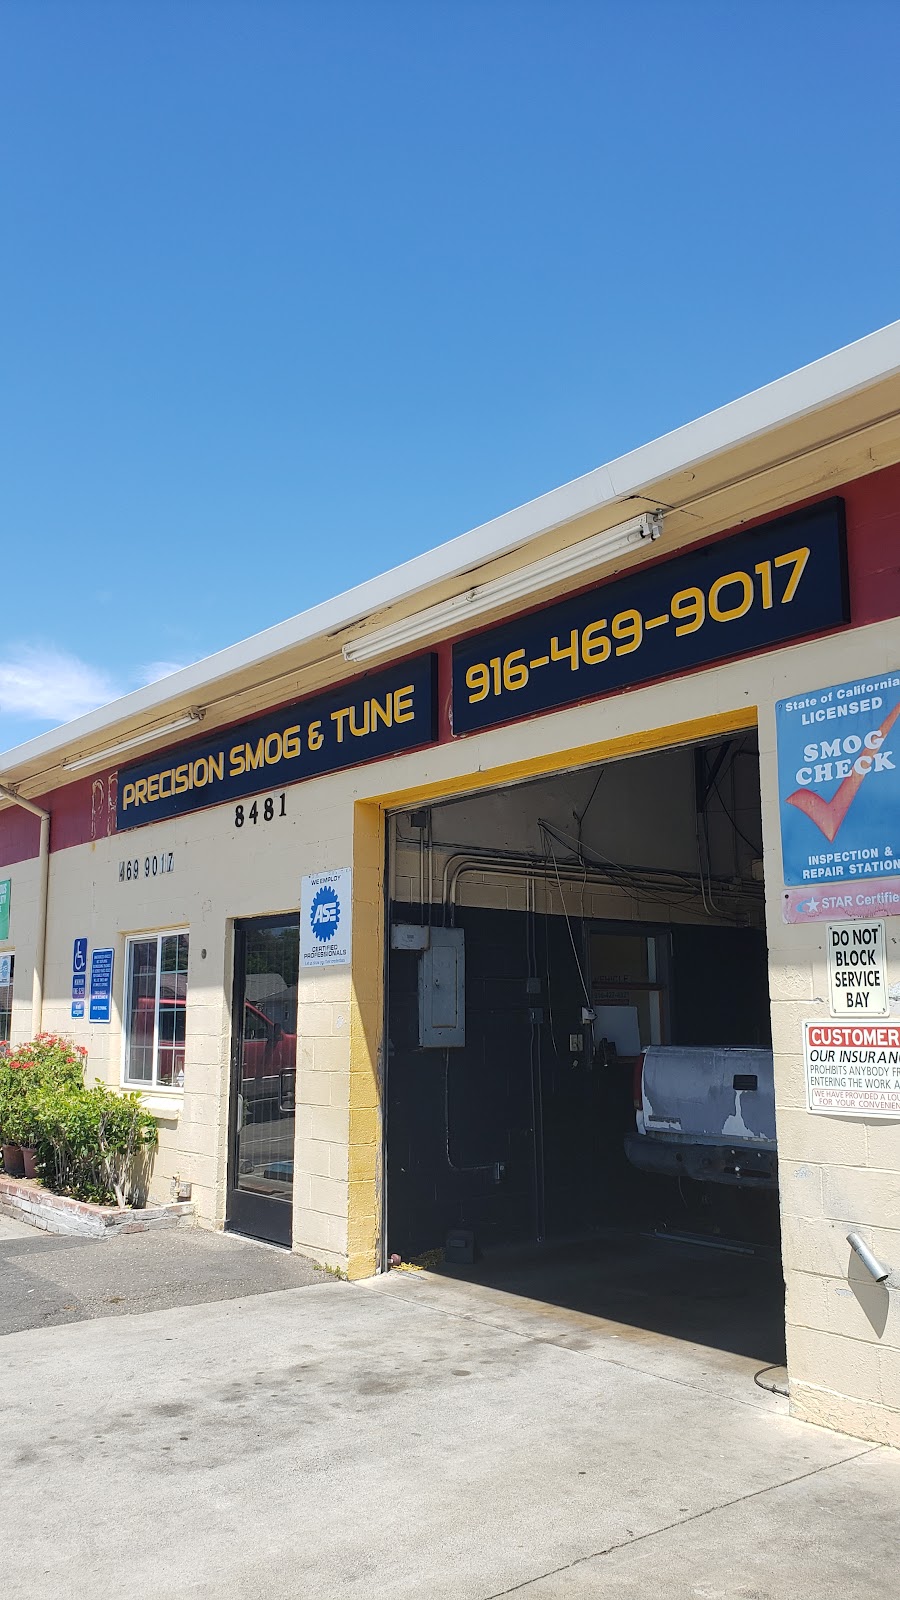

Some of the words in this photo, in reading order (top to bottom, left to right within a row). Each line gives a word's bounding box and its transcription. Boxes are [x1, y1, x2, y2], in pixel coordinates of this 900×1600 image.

[464, 546, 811, 704] 916-469-9017
[785, 698, 817, 712] State
[820, 692, 832, 703] of
[836, 677, 900, 700] California
[801, 696, 883, 726] LICENSED
[121, 751, 225, 810] PRECISION
[229, 725, 301, 777] SMOG
[308, 720, 324, 751] &
[330, 684, 415, 743] TUNE
[803, 730, 885, 762] SMOG
[795, 751, 896, 785] CHECK
[234, 792, 287, 828] 8481
[808, 848, 879, 866] INSPECTION
[884, 846, 893, 857] &
[119, 859, 139, 882] 469
[145, 852, 174, 877] 9017
[802, 866, 844, 880] REPAIR
[849, 858, 900, 875] STATION
[822, 895, 853, 909] STAR
[313, 902, 337, 924] ASE
[832, 930, 849, 947] DO
[852, 928, 878, 946] NOT
[304, 949, 347, 959] PROFESSIONALS
[312, 944, 338, 953] CERTIFIED
[835, 949, 876, 967] BLOCK
[835, 970, 881, 988] SERVICE
[846, 991, 870, 1008] BAY
[811, 1028, 900, 1046] CUSTOMER
[810, 1049, 836, 1062] OUR
[839, 1050, 900, 1064] INSURAN
[810, 1065, 847, 1075] PROHIBITS
[849, 1066, 889, 1076] ANYBODY
[810, 1077, 846, 1087] ENTERING
[848, 1078, 863, 1088] THE
[865, 1079, 891, 1089] WORK
[835, 1099, 856, 1107] YOUR
[845, 1092, 879, 1100] PROVIDED
